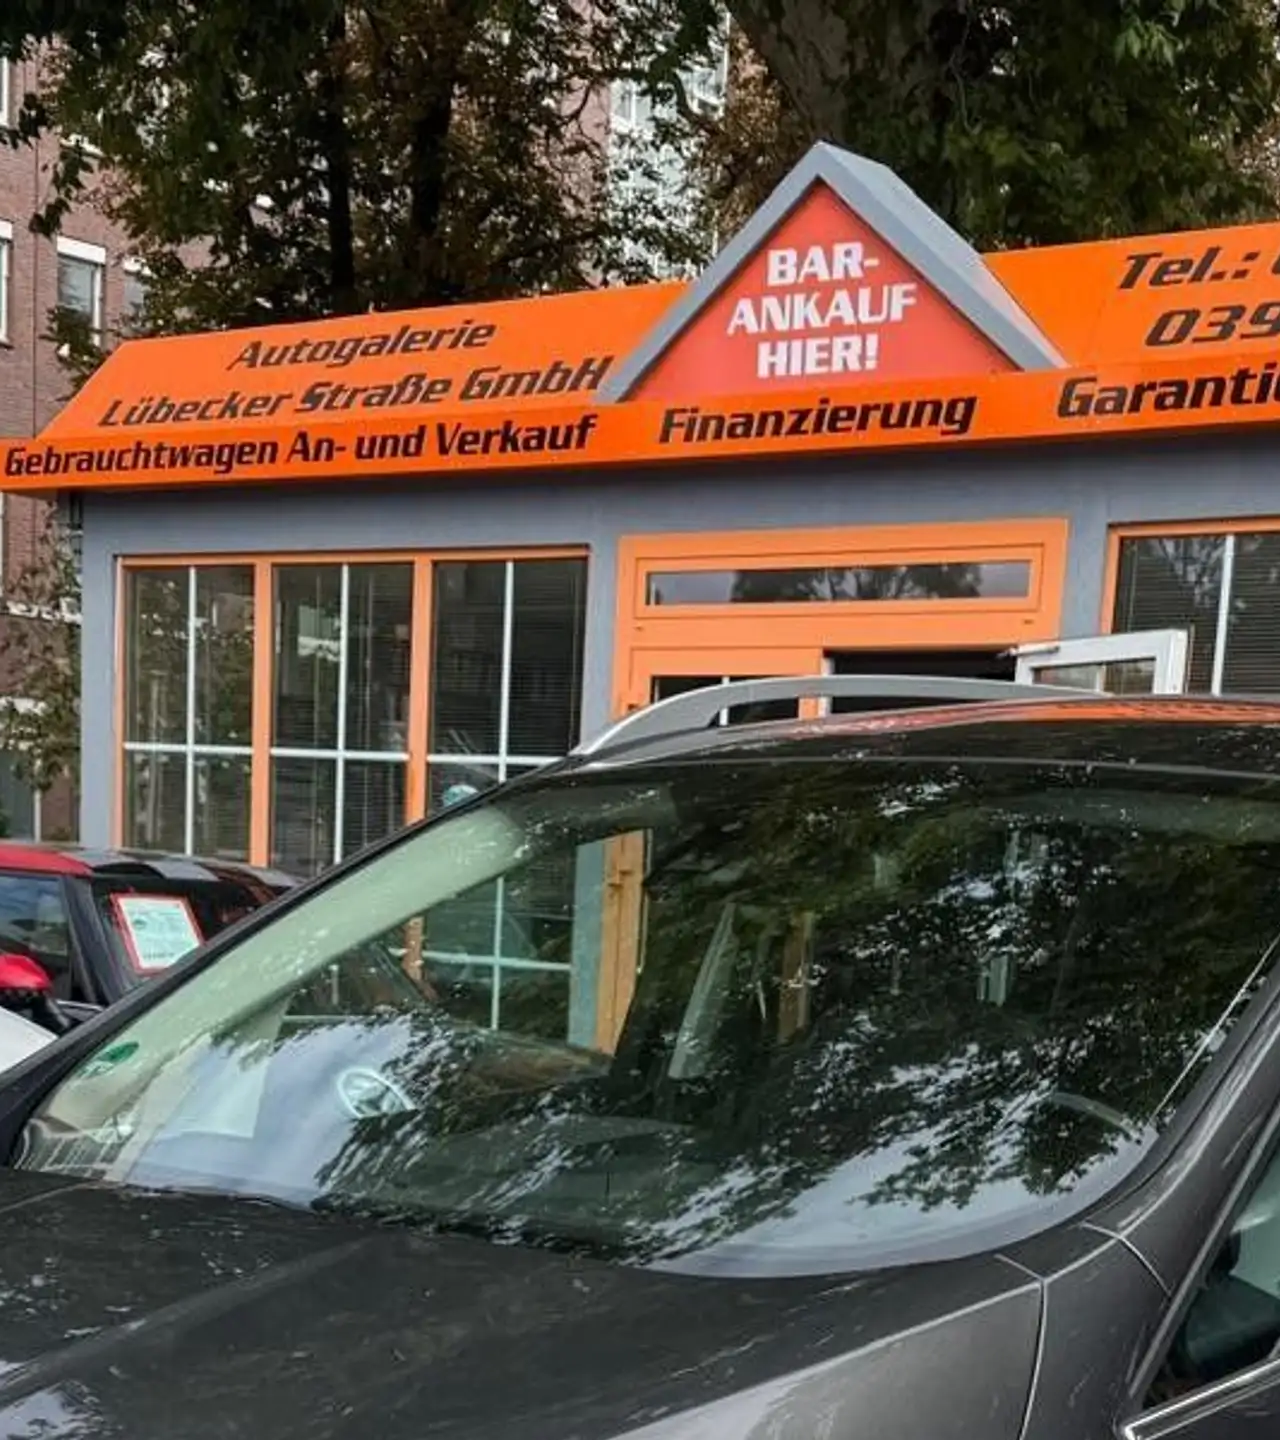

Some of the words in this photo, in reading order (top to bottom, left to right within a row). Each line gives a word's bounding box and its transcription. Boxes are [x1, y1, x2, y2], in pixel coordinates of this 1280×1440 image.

[767, 241, 880, 287] BAR-
[1119, 245, 1260, 289] Tel.:
[726, 283, 917, 336] ANKAUF
[225, 319, 497, 370] Autogalerie
[756, 333, 879, 379] HIER!
[98, 390, 294, 427] Lübecker
[294, 372, 452, 412] Straße
[458, 355, 614, 401] GmbH
[658, 395, 978, 443] Finanzierung
[4, 440, 278, 477] Gebrauchtwagen
[284, 430, 347, 464] An-
[354, 424, 426, 459] und
[436, 413, 598, 456] Verkauf
